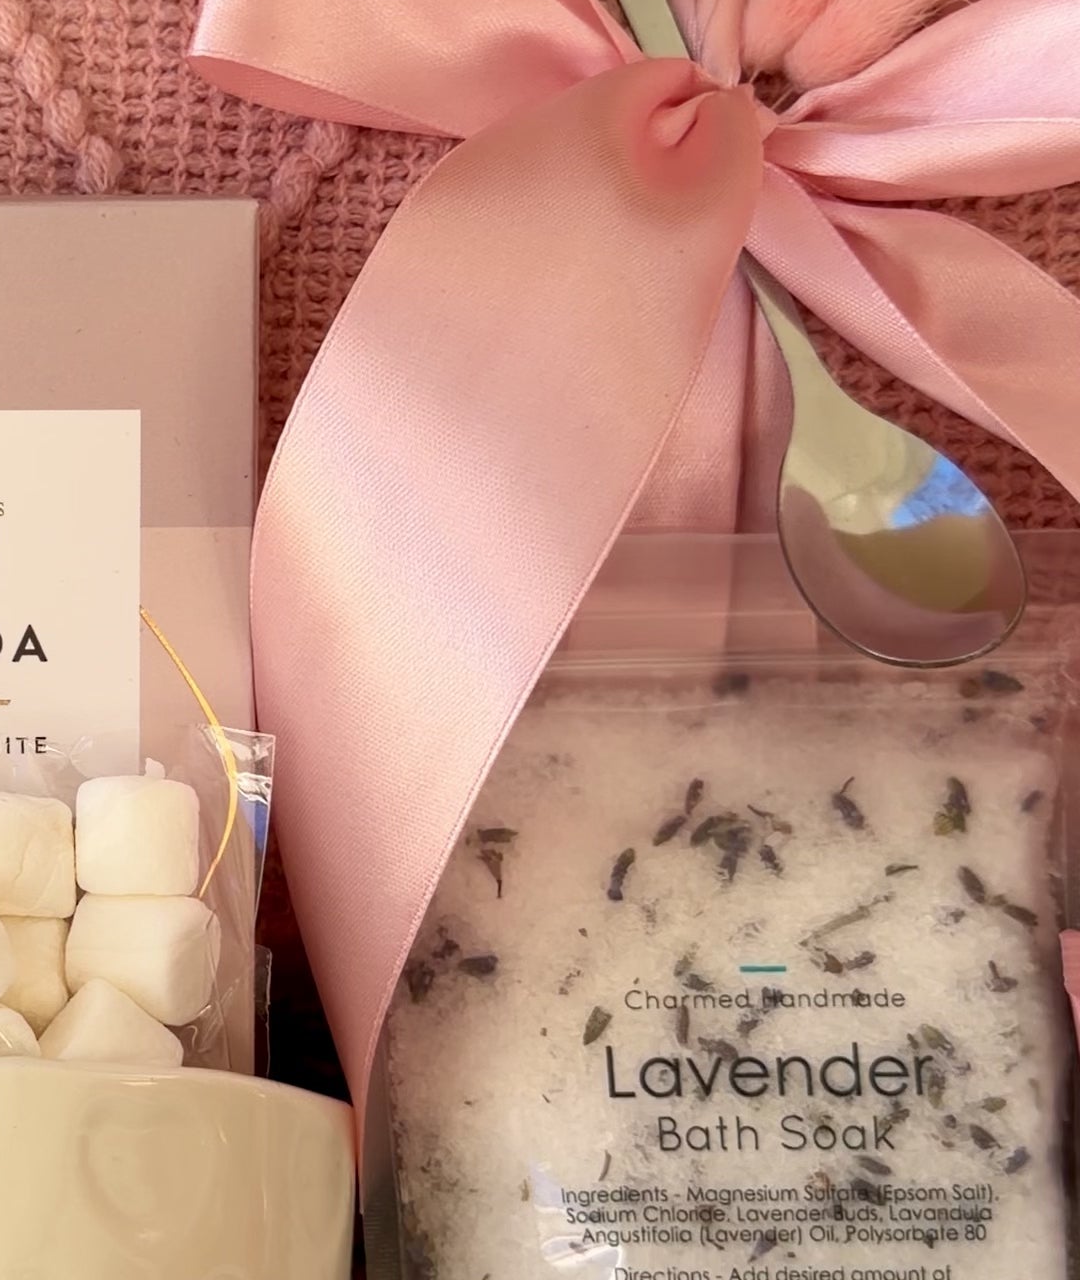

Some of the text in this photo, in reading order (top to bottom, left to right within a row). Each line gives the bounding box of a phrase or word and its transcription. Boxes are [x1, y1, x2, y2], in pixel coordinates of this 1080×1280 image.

[624, 988, 906, 1010] Charmed Handmade
[605, 1042, 935, 1098] Lavender
[658, 1114, 896, 1152] Bath Soak
[561, 1187, 669, 1208] Ingredients
[686, 1186, 799, 1206] Magnesium
[876, 1184, 948, 1204] (Epsom
[566, 1205, 638, 1223] Sodium
[736, 1204, 830, 1222] Lavender
[889, 1203, 993, 1222] Lavandula
[582, 1226, 692, 1246] Angustifolia
[699, 1225, 802, 1245] (Lavender)
[845, 1224, 961, 1245] Polysorbate
[964, 1224, 987, 1241] 80
